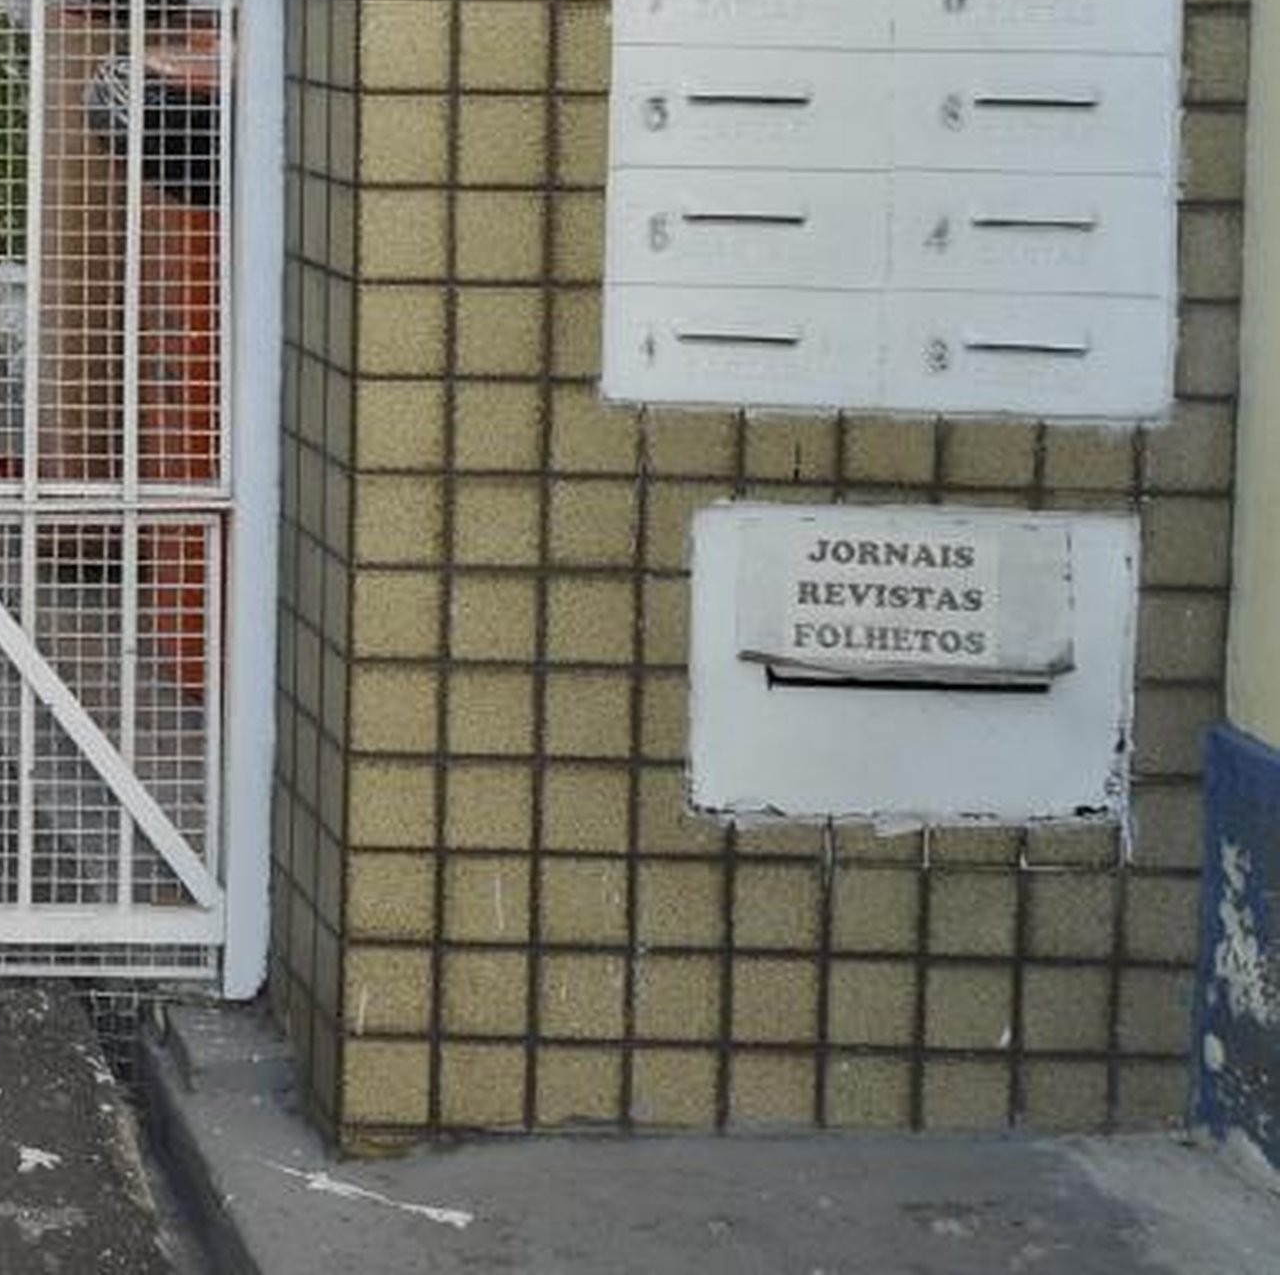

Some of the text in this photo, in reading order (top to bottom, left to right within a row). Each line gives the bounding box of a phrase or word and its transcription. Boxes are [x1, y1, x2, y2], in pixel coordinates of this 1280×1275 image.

[807, 539, 976, 569] JORNAIS
[796, 581, 984, 612] REVISTAS
[793, 623, 987, 655] FOLHETOS
